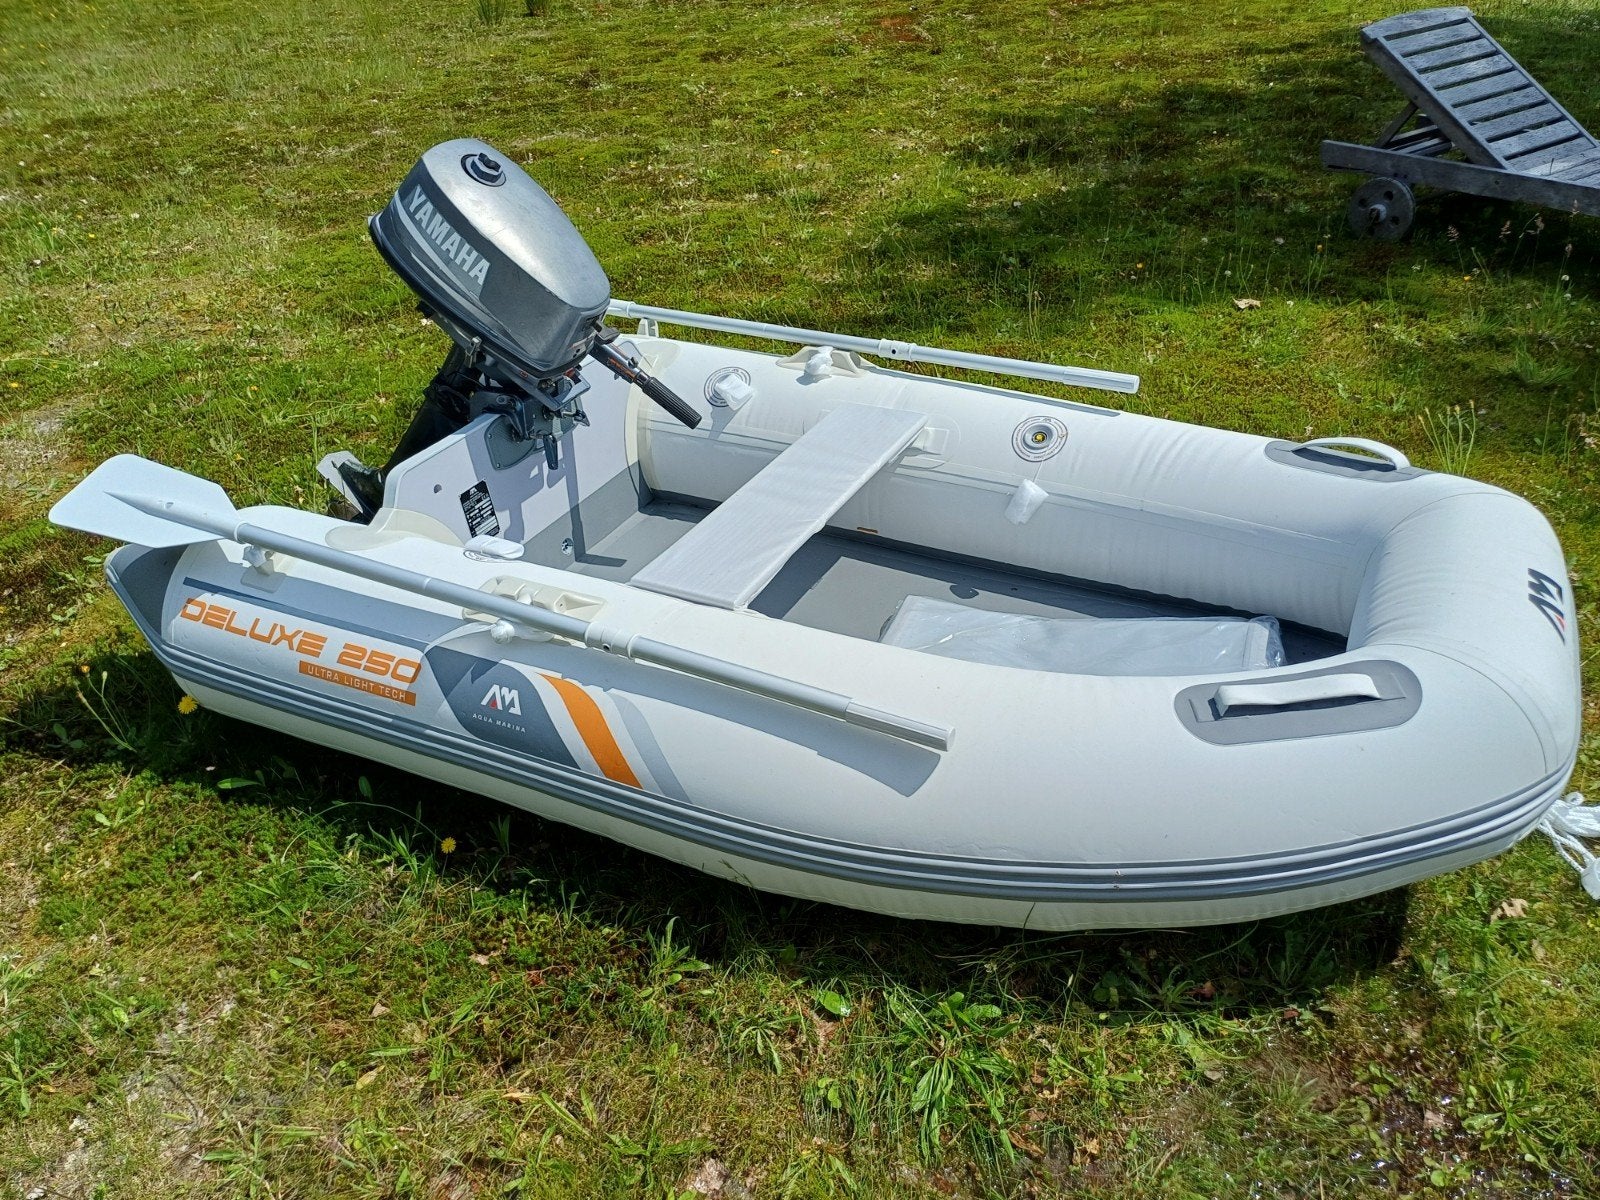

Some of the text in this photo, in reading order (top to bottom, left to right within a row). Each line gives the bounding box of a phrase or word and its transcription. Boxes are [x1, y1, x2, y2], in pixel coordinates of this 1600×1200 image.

[406, 184, 492, 286] YAMAHA
[179, 597, 422, 684] DELUXE 250
[306, 664, 407, 703] ULTRA LIGHT TECH
[472, 713, 527, 734] AQUA MARINA
